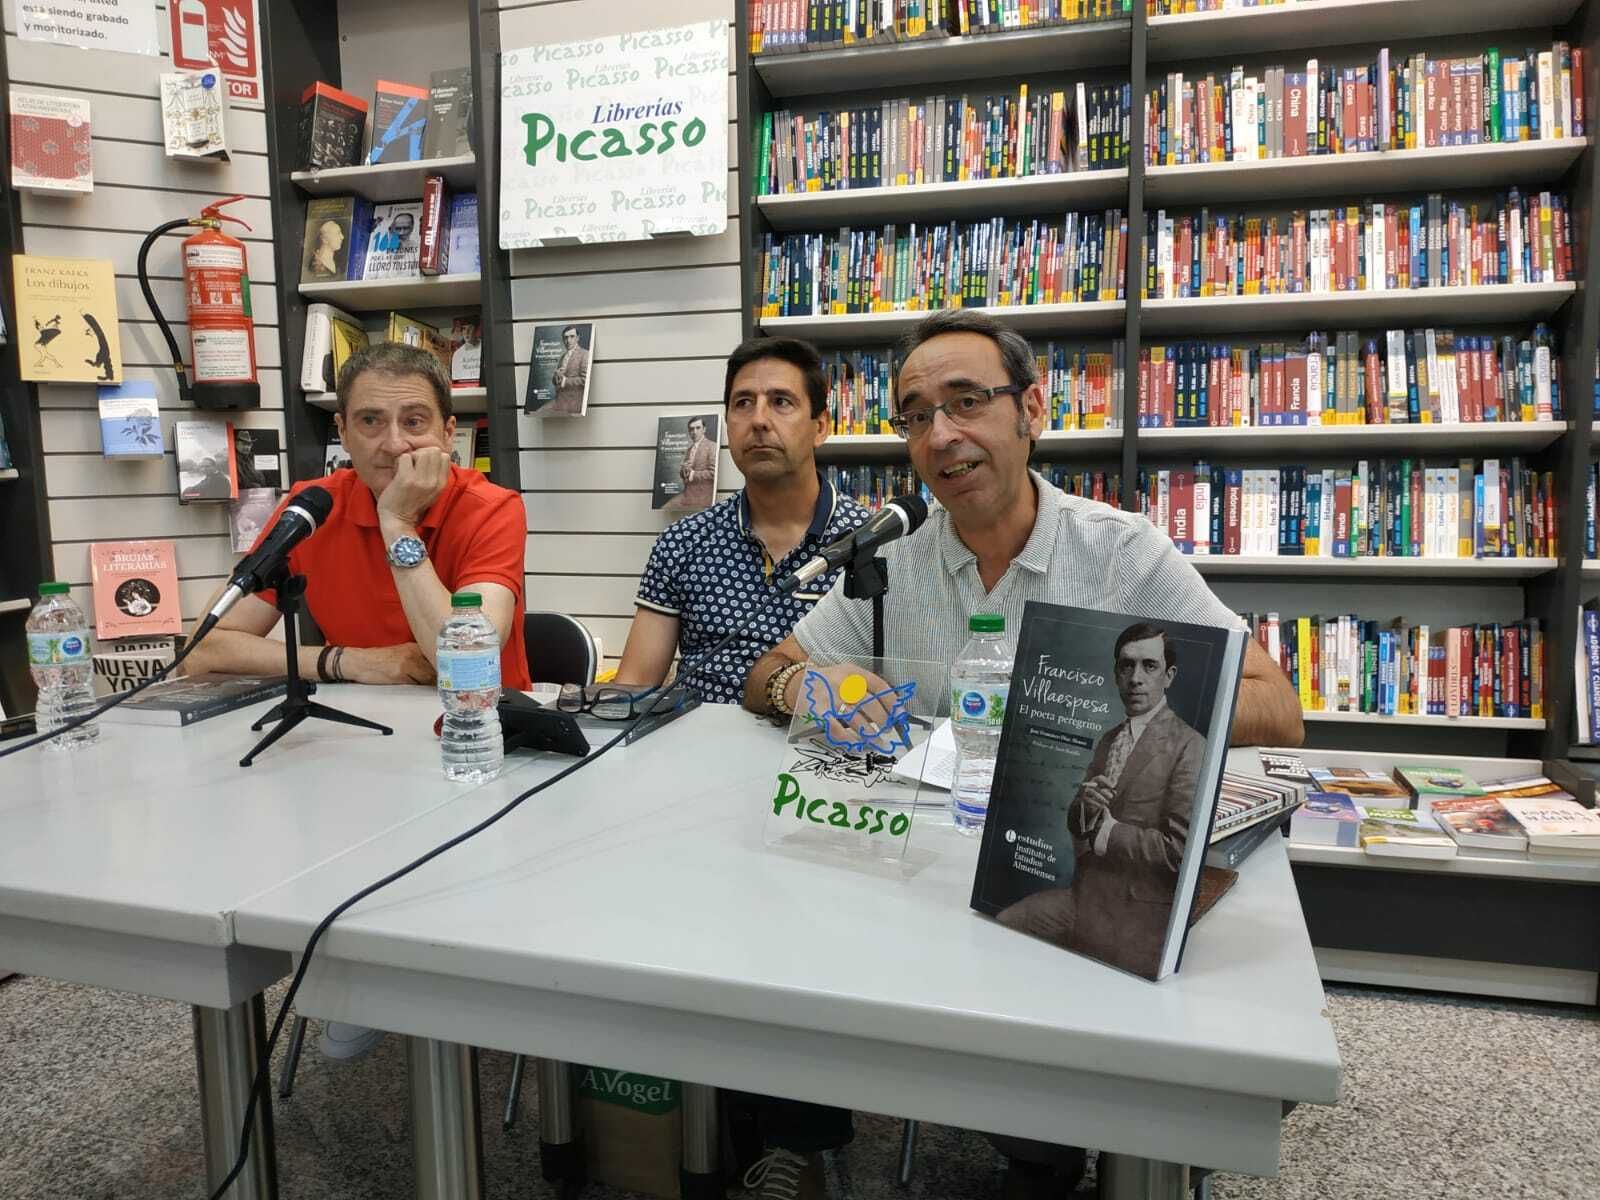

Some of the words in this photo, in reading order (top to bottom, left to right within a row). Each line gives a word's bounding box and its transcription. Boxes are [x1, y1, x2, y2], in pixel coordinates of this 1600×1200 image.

[48, 6, 83, 19] siendo
[86, 11, 129, 25] grabado
[23, 22, 31, 32] y
[33, 23, 108, 39] monitorizado.
[566, 67, 640, 90] Picasso
[1290, 88, 1301, 117] China
[1346, 84, 1354, 105] Corea
[592, 97, 684, 124] Librerías
[1359, 116, 1367, 138] Corea
[521, 112, 706, 167] Picasso
[525, 198, 597, 219] Picasso
[610, 190, 686, 212] Picasso
[1336, 224, 1345, 243] Egipto
[25, 267, 56, 275] FRANZ
[59, 269, 89, 277] KAFKA
[1387, 250, 1395, 274] Escocia
[26, 279, 46, 288] Los
[48, 280, 90, 292] dibujos
[1181, 265, 1190, 283] Cuba
[1291, 377, 1300, 410] Francia
[1196, 485, 1206, 510] India
[1229, 487, 1239, 527] Indonesia
[1323, 492, 1331, 520] Irlanda
[1174, 508, 1187, 539] India
[1269, 506, 1277, 527] India
[1337, 512, 1347, 539] Irlanda
[104, 561, 167, 572] LITERARIAS
[113, 553, 154, 562] BRUJAS
[93, 657, 167, 678] NUEVA
[1038, 654, 1104, 686] Francisco
[1023, 676, 1109, 717] Villaespesa
[1019, 704, 1029, 714] El
[1030, 709, 1055, 720] poeta
[1057, 715, 1102, 731] peregrino
[772, 773, 910, 836] Picasso
[1016, 843, 1046, 860] Instituto
[1046, 854, 1056, 864] de
[1018, 835, 1053, 851] estudios
[1012, 861, 1056, 881] Almerienses
[1014, 852, 1043, 867] Estudios
[581, 1069, 674, 1104] A.Vogel
